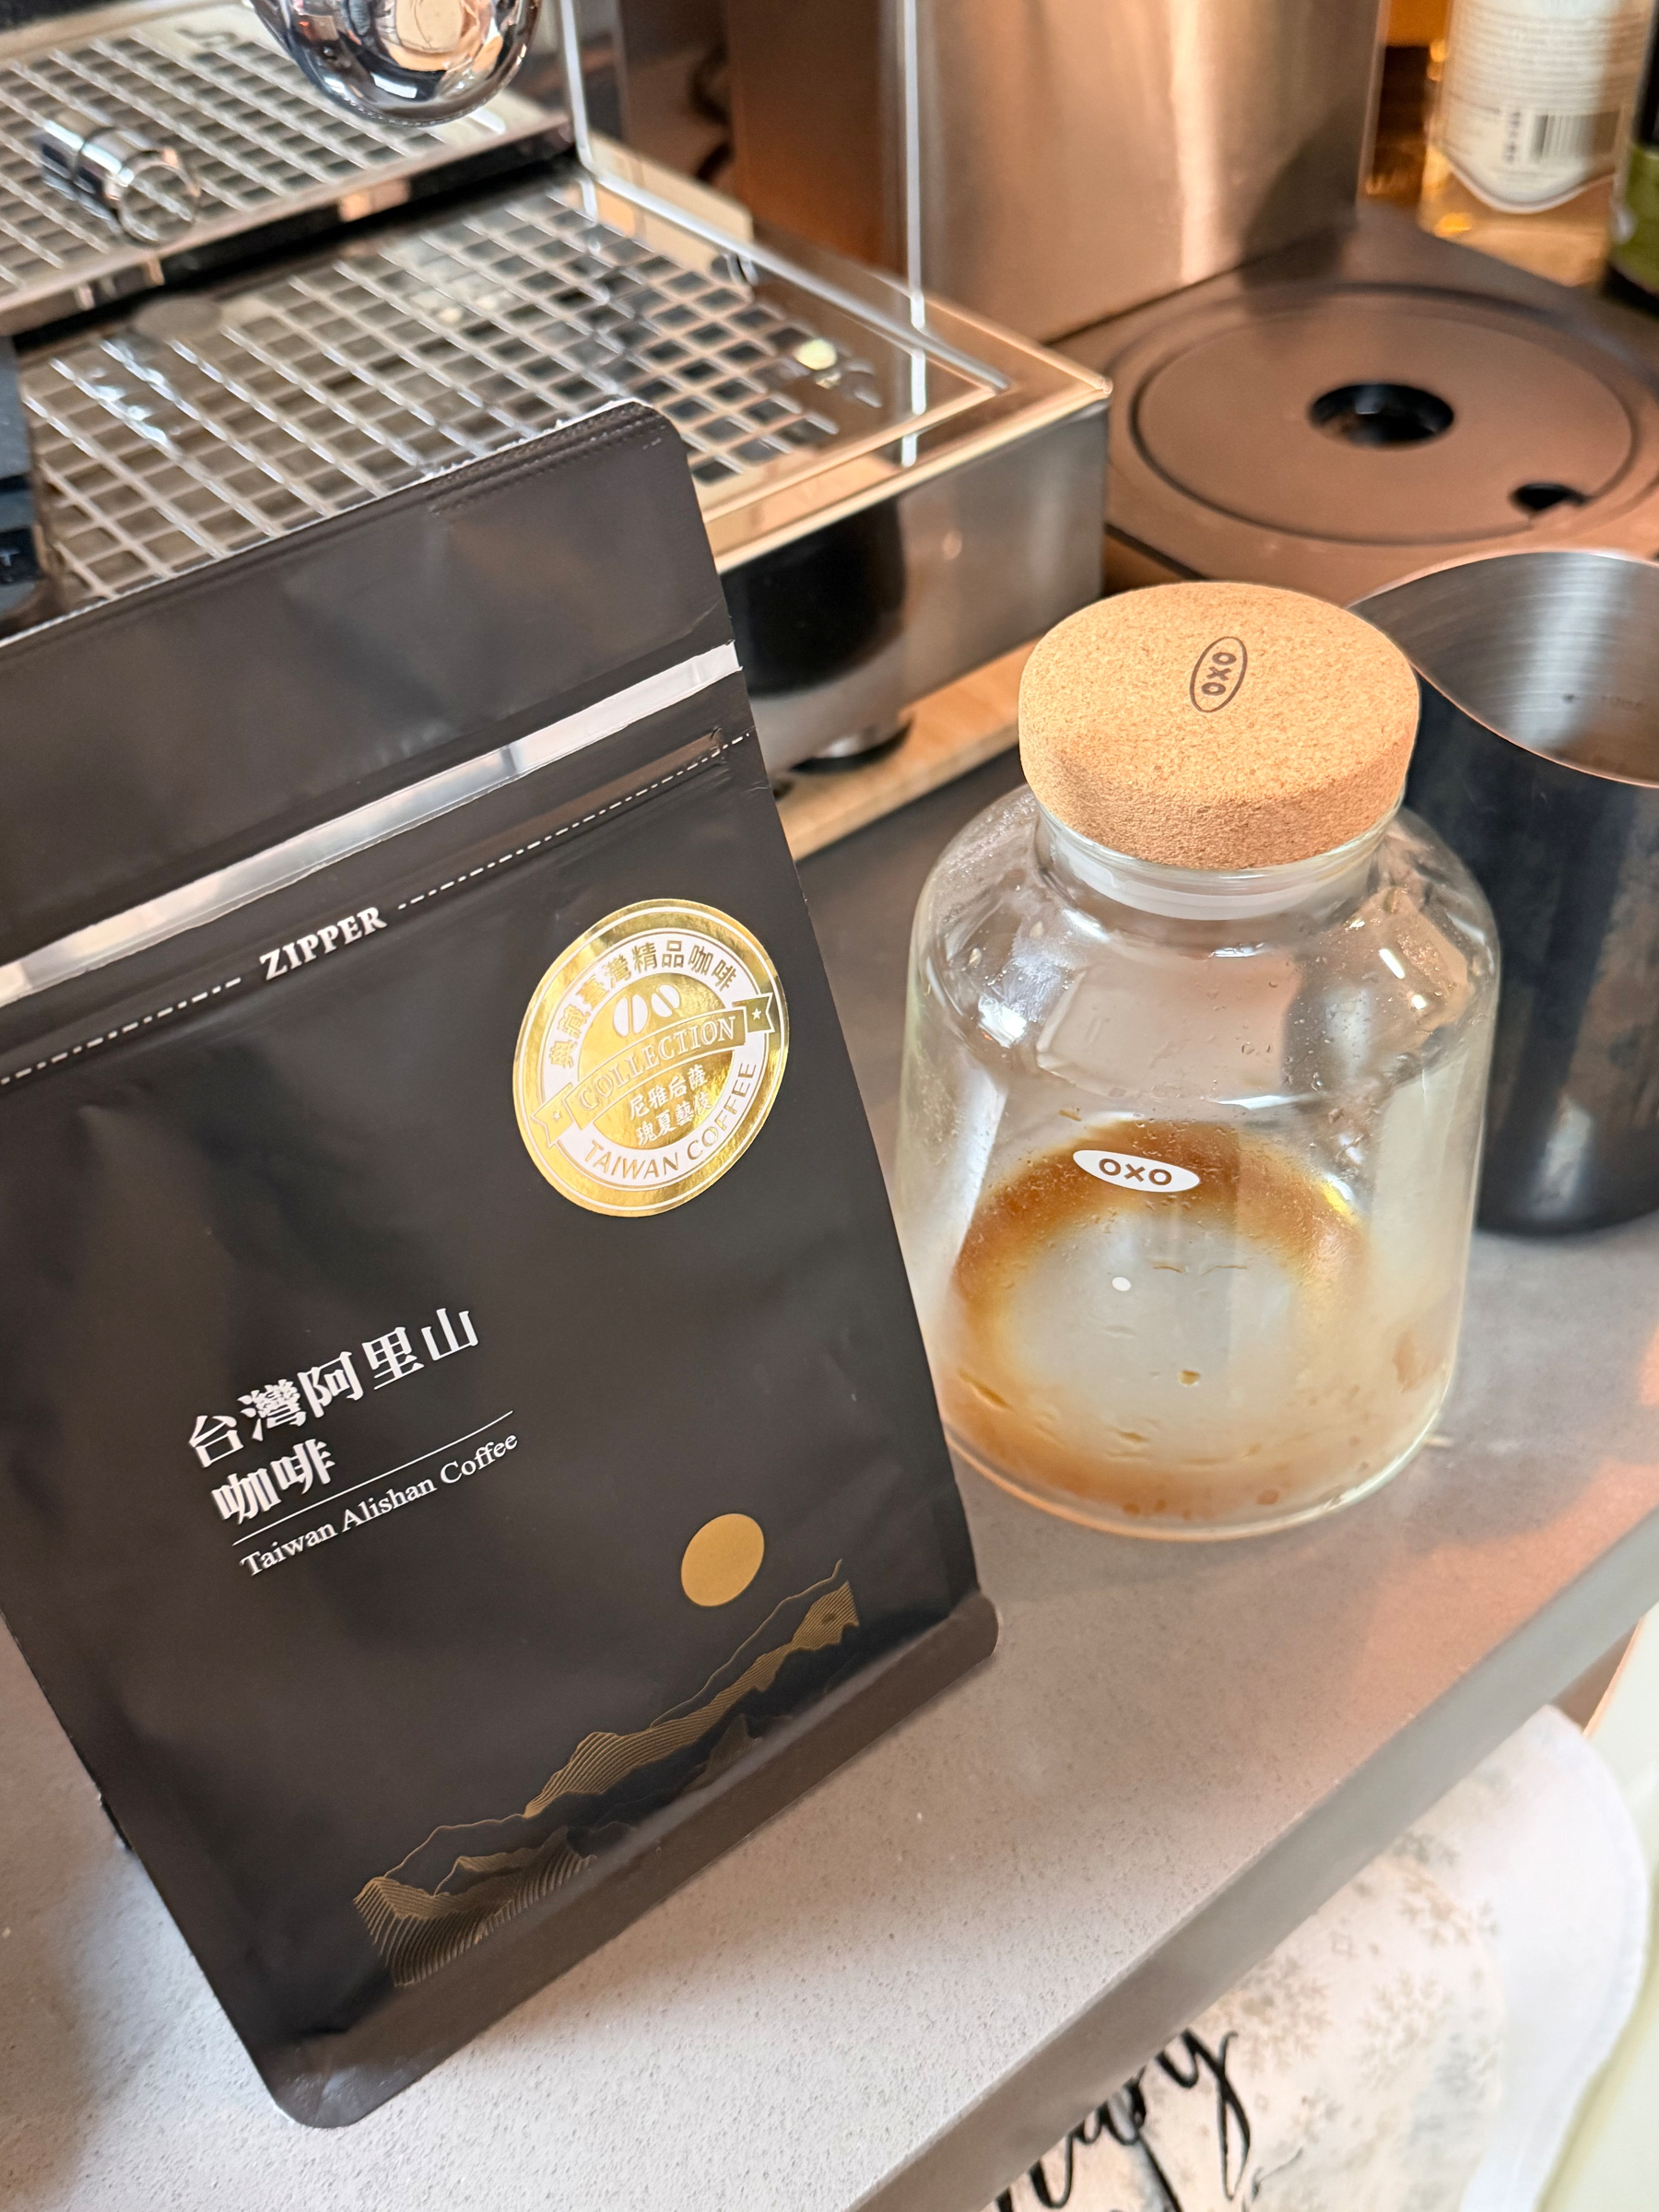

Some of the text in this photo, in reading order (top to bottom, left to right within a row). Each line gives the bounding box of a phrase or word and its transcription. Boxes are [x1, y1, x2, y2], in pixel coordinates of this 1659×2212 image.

[1200, 652, 1237, 696] OXO
[259, 907, 388, 981] ZIPPER
[578, 1015, 736, 1112] COLLECTION
[583, 1062, 757, 1180] TAIWAN COFFEE
[1099, 1158, 1172, 1186] OXO
[189, 1307, 479, 1468] 台灣阿里山
[211, 1438, 335, 1525] 咖啡
[240, 1434, 519, 1577] Taiwan Alishan Coffee
